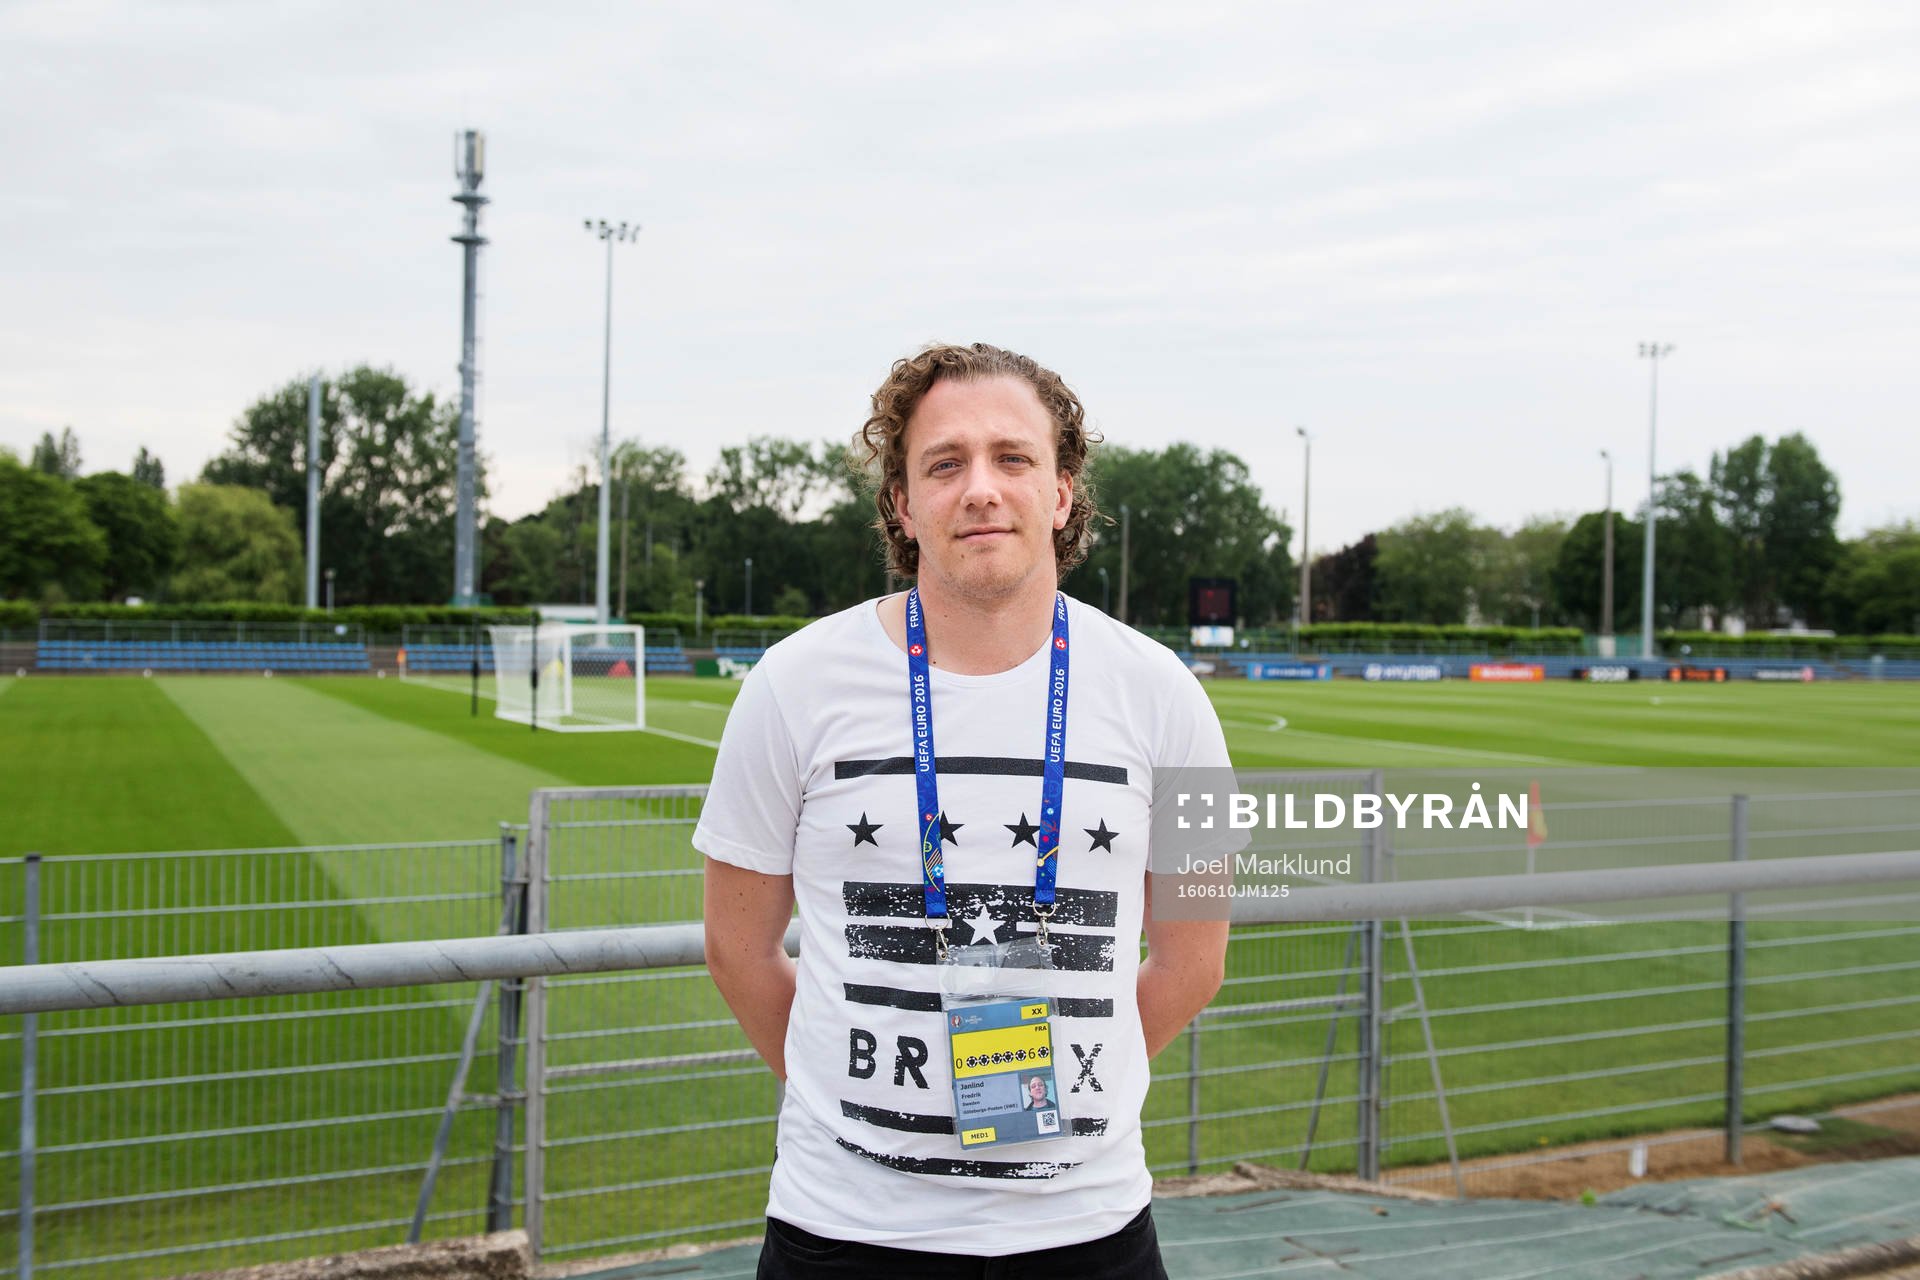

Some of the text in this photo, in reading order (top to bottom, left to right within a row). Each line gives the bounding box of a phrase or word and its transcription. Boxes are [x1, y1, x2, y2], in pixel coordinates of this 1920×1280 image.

[1050, 668, 1065, 763] UEFA EURO 2016
[914, 674, 930, 772] UEFA EURO 2016
[1031, 1007, 1043, 1016] XX
[1034, 1025, 1048, 1033] FRA
[955, 1047, 1036, 1070] 0 6
[960, 1081, 985, 1090] Janlind
[970, 1132, 989, 1140] MED1
